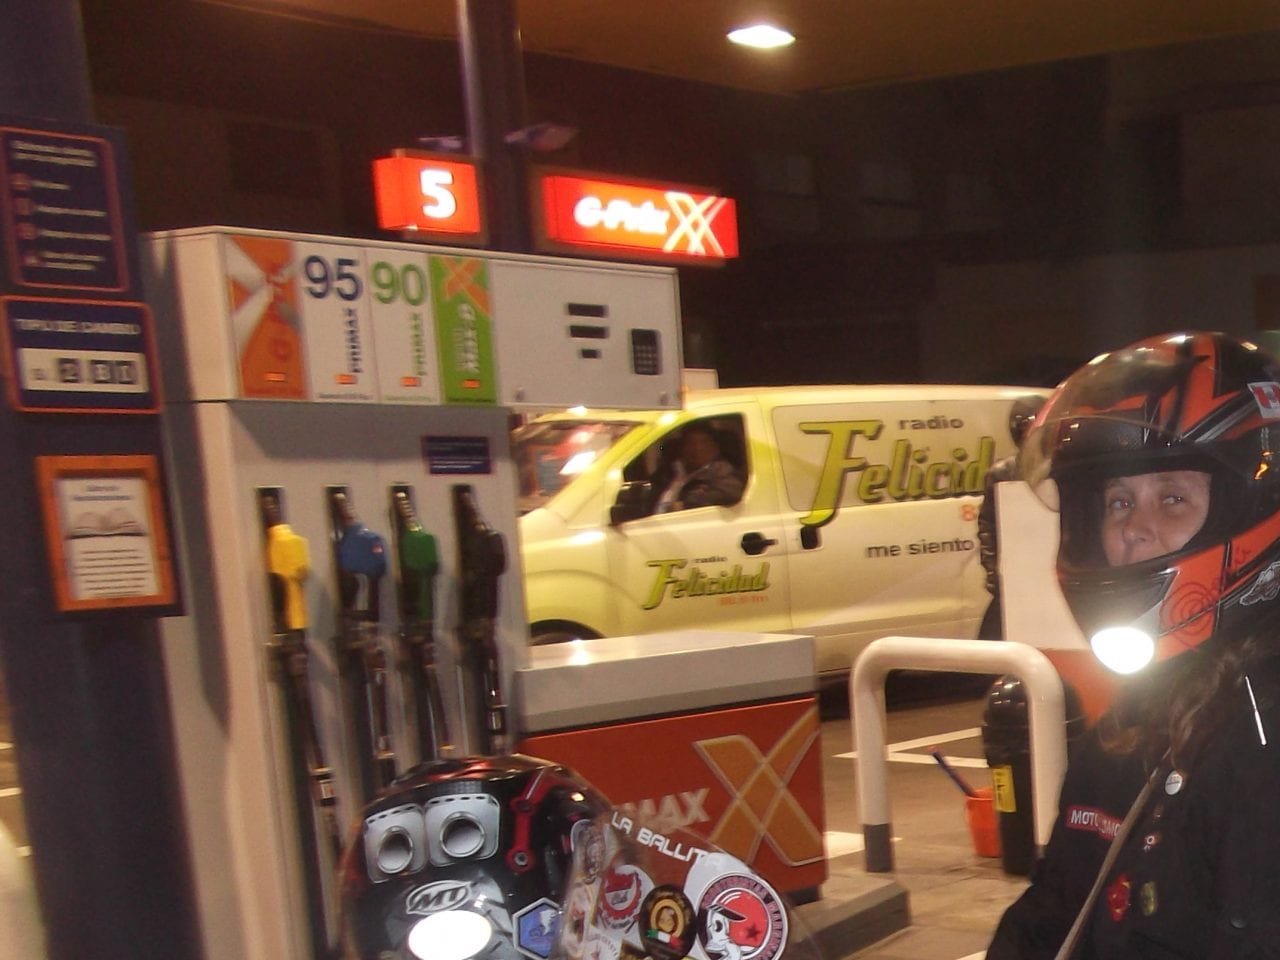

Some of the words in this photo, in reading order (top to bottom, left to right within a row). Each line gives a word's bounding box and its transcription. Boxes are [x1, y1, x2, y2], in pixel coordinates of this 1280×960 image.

[419, 168, 456, 219] 5
[303, 255, 363, 302] 95
[371, 260, 426, 307] 90
[899, 415, 964, 431] radio
[800, 420, 995, 528] Felicid
[867, 542, 900, 559] me
[908, 537, 976, 557] siento
[612, 811, 633, 834] LA
